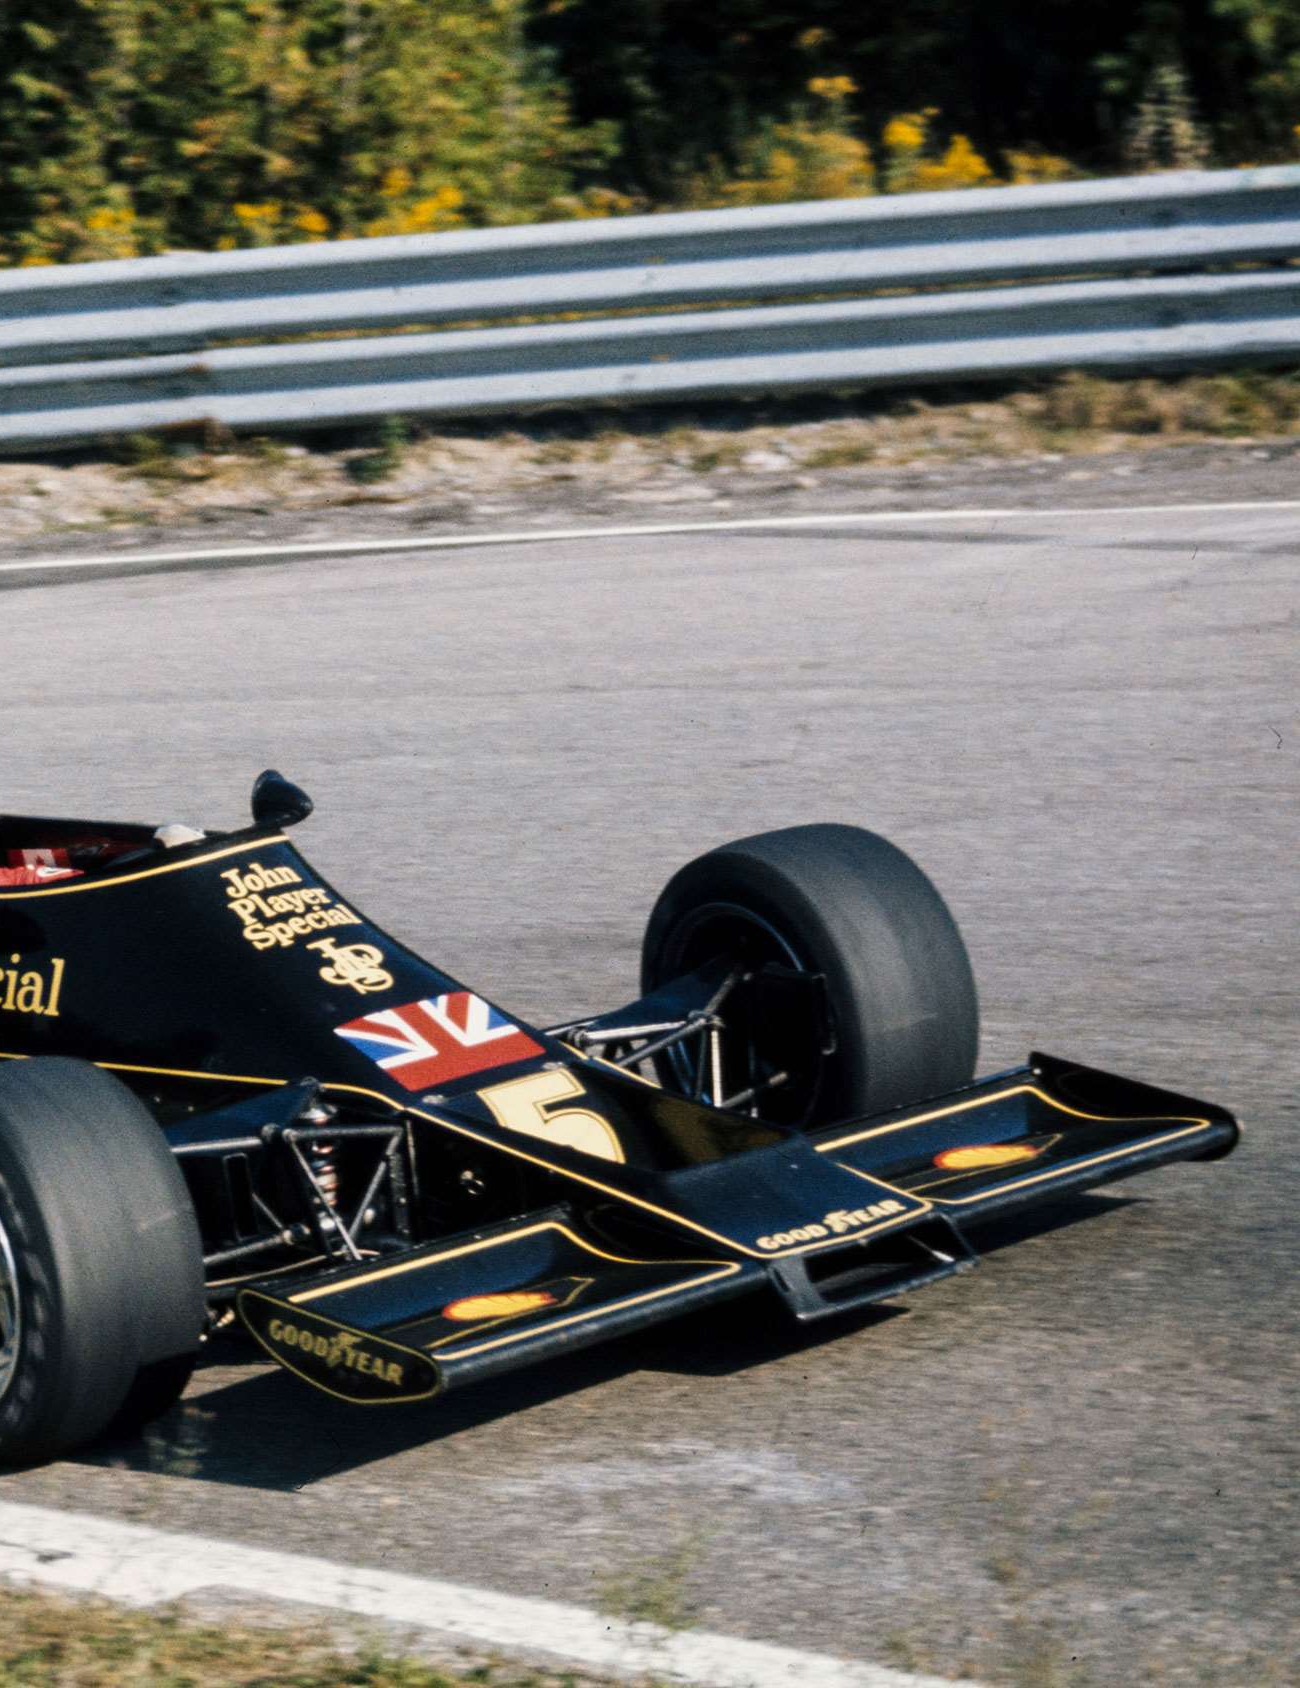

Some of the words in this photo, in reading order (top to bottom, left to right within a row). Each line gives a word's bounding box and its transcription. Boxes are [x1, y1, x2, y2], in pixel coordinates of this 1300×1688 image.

[220, 862, 302, 898] John
[227, 888, 332, 926] Player
[243, 904, 363, 950] Special
[476, 1068, 626, 1164] 5
